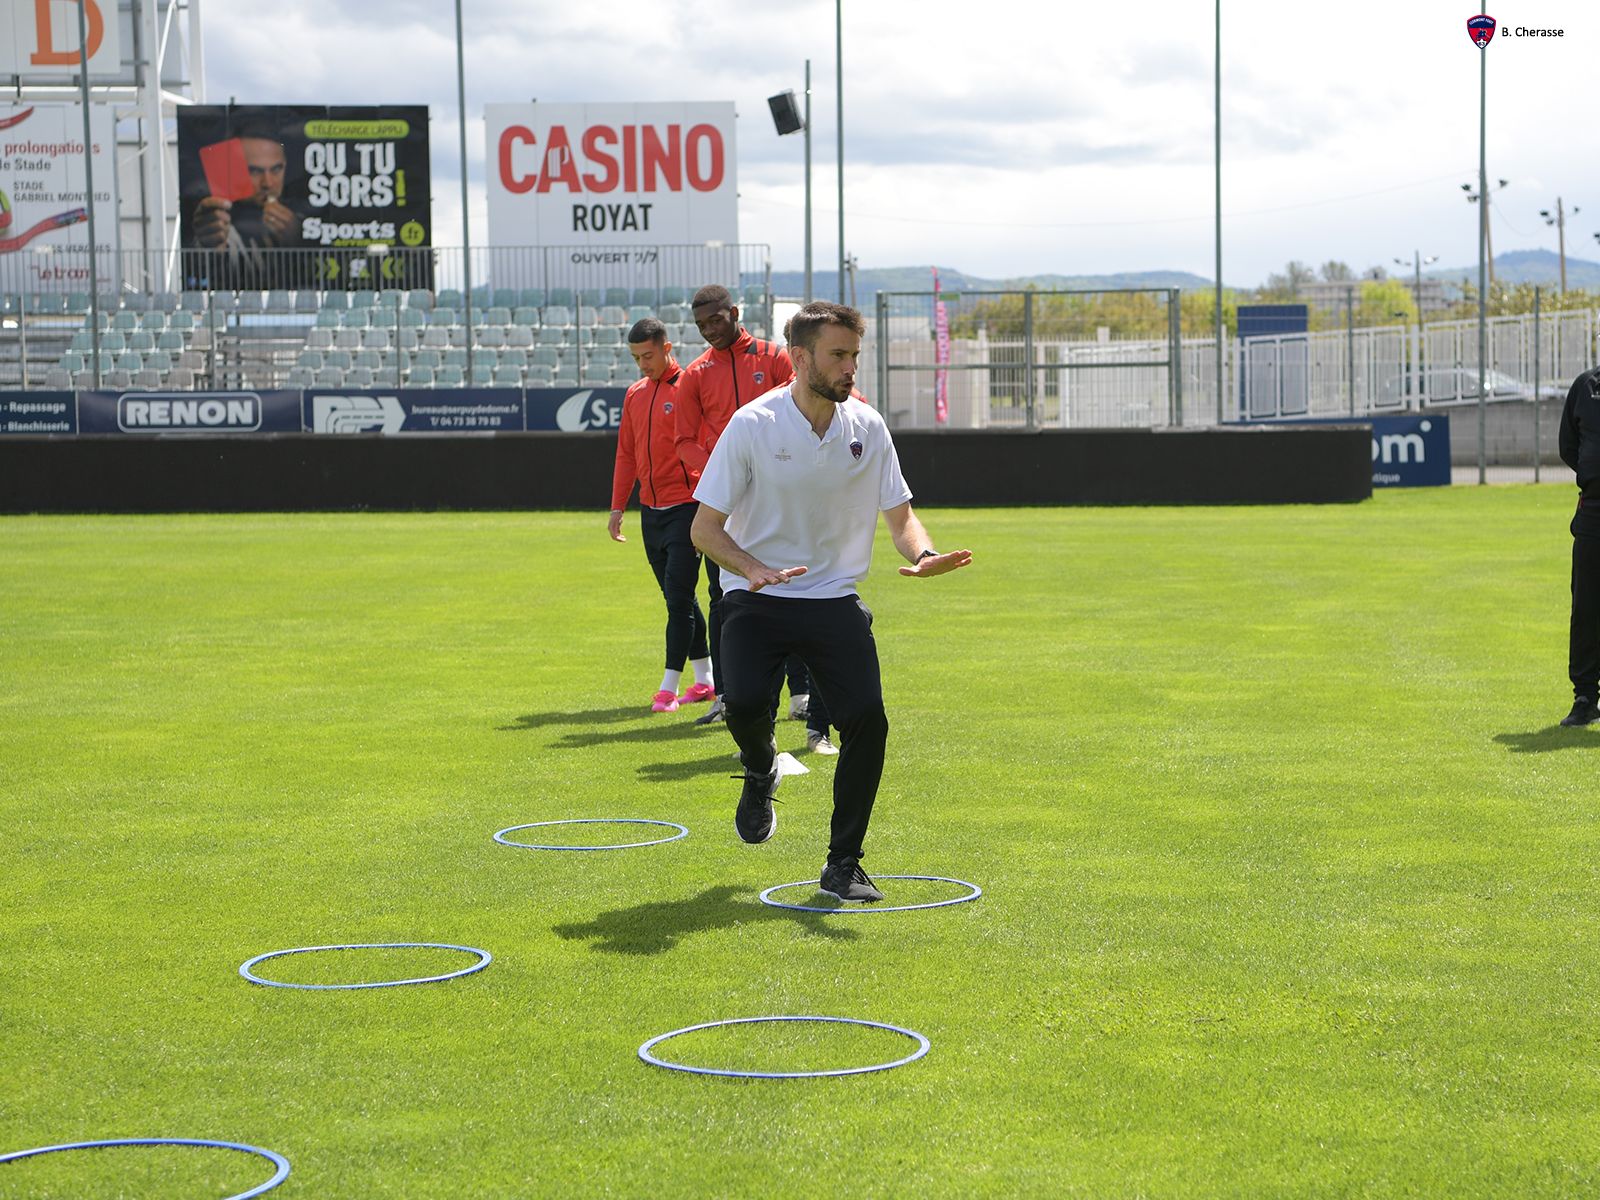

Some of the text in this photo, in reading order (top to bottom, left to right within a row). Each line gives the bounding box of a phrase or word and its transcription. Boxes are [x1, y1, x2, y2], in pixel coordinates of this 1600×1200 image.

[30, 0, 104, 65] D
[5, 140, 100, 158] prolongatios
[15, 157, 51, 171] Stade
[354, 142, 396, 176] TU
[498, 123, 724, 194] CASINO
[13, 181, 44, 191] STADE
[14, 191, 110, 203] GABRIEL MONTIED
[572, 204, 652, 232] ROYAT
[303, 217, 396, 245] Sports
[571, 252, 630, 264] OUVERT
[10, 401, 66, 415] Repassage
[126, 400, 253, 425] RENON
[8, 420, 70, 432] Blanchisserie
